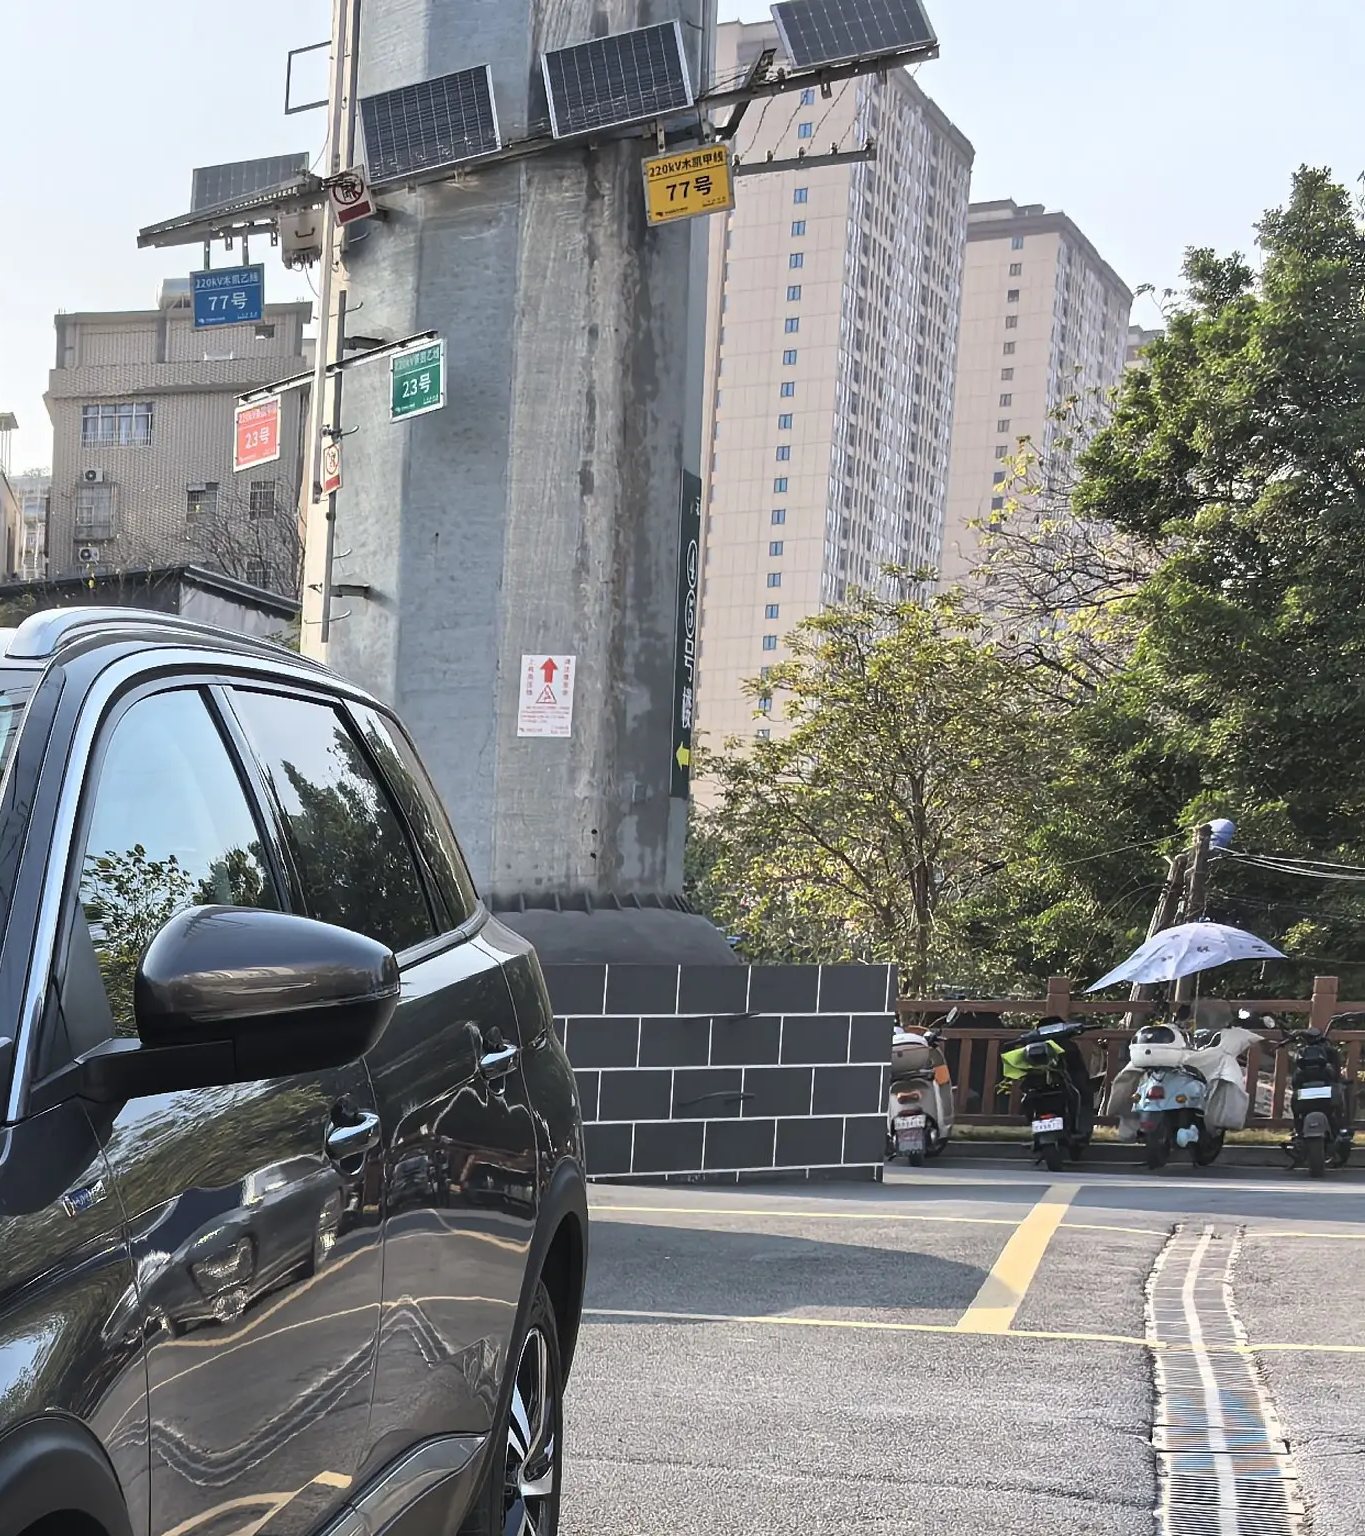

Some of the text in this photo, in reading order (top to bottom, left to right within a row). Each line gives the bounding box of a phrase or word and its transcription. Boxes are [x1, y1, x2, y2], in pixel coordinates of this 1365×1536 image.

[665, 175, 713, 202] 77号
[208, 291, 248, 311] 77号
[402, 372, 431, 399] 23号
[245, 427, 270, 449] 23号
